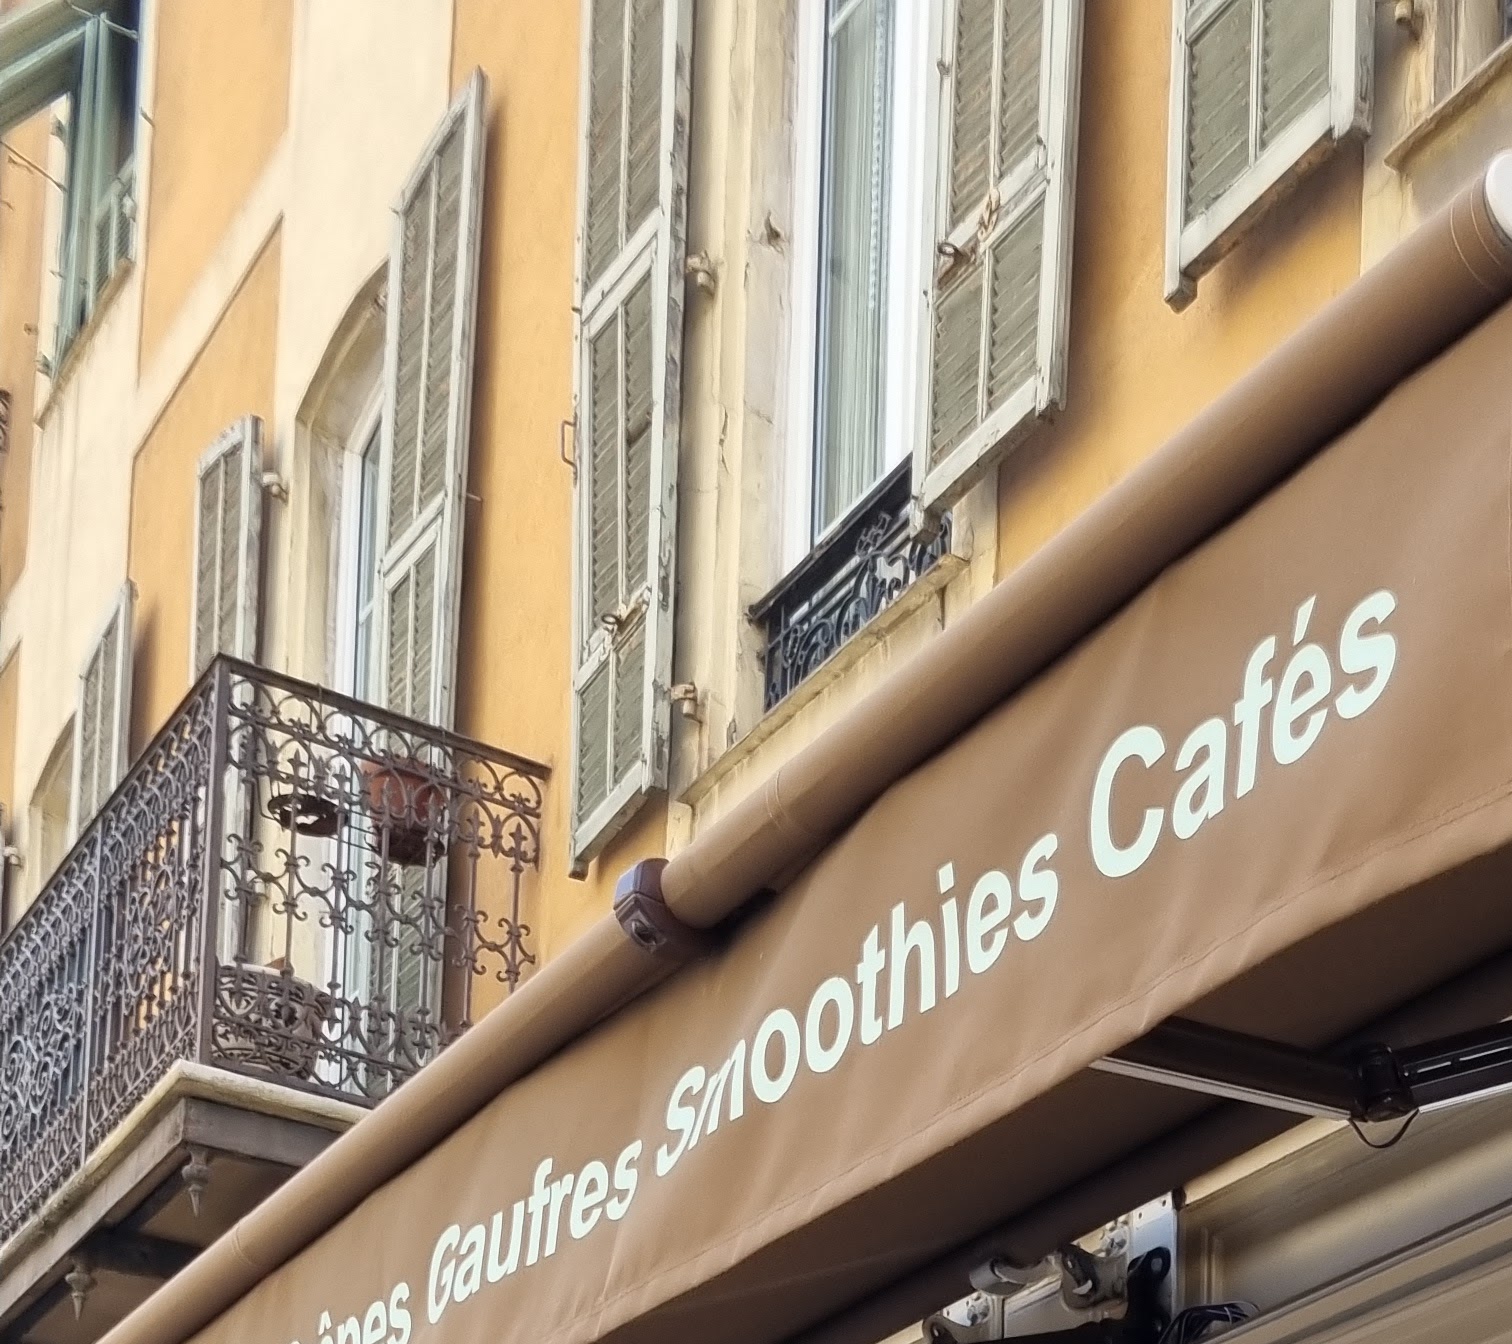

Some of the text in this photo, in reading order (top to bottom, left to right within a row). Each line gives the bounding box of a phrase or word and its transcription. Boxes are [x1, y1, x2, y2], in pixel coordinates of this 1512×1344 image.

[427, 1140, 642, 1324] Gaufres
[658, 833, 1059, 1179] Smoothies
[1090, 589, 1398, 878] Cafés
